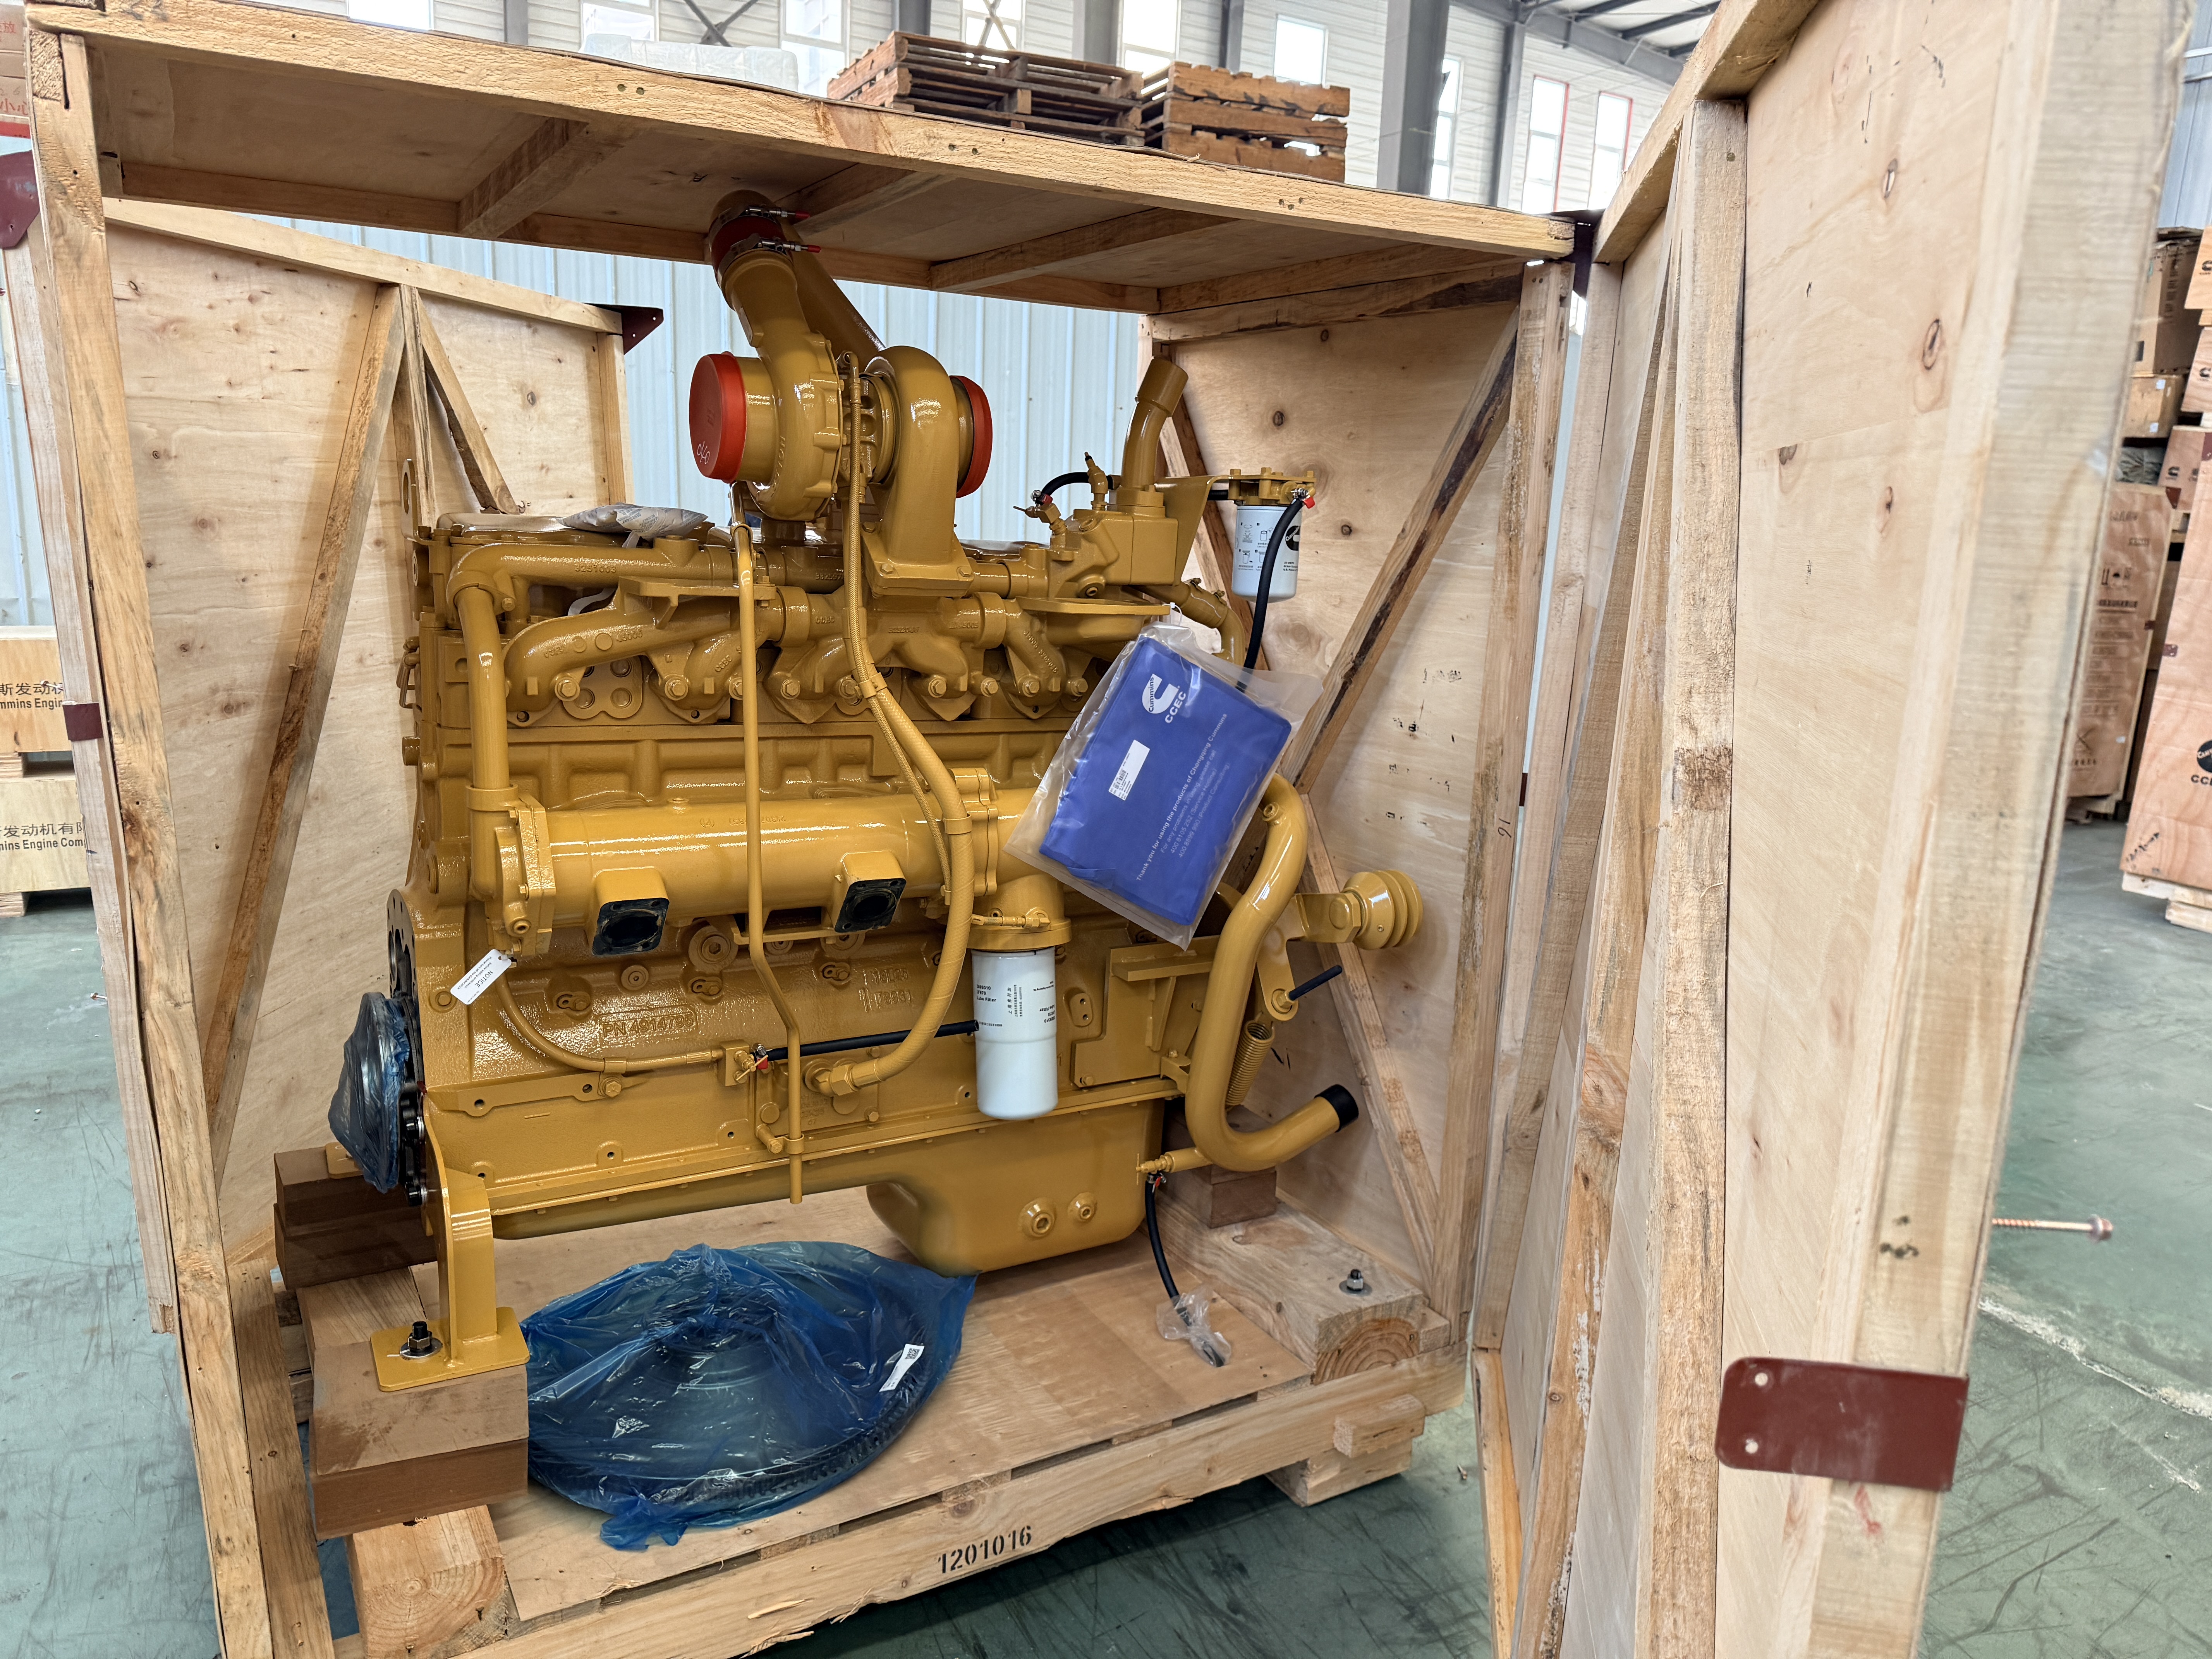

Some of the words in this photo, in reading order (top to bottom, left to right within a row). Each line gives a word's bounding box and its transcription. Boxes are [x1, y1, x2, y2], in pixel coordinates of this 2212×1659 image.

[1164, 691, 1187, 723] CCEC
[1137, 862, 1149, 881] Thank
[1158, 823, 1169, 839] using
[1173, 784, 1188, 811] products
[1190, 742, 1211, 775] Chongqing
[1208, 713, 1227, 741] Cummins
[1173, 805, 1187, 831] problems
[0, 823, 82, 838] 发动机有
[1177, 826, 1186, 842] 8105
[23, 839, 58, 850] Engine
[61, 838, 86, 848] Com
[475, 970, 493, 988] NOTICE
[602, 1022, 627, 1037] PN
[629, 1013, 694, 1034] 4914795
[938, 1525, 1032, 1573] 1201016
